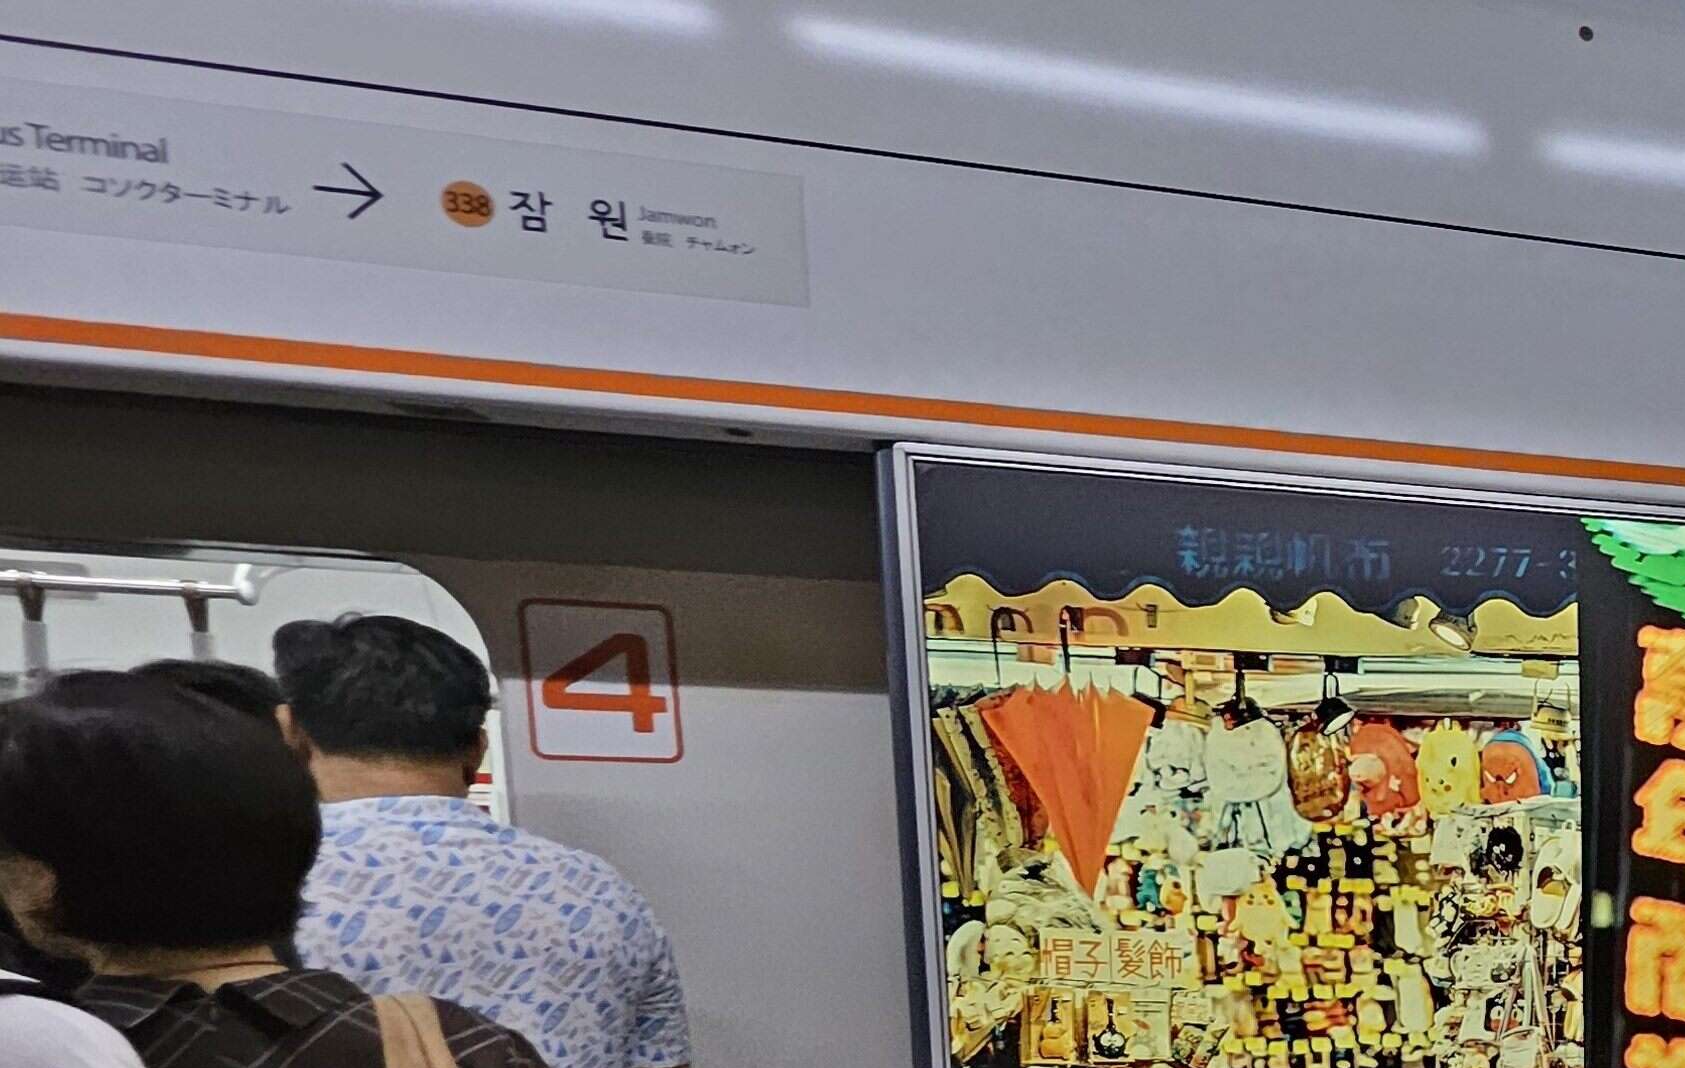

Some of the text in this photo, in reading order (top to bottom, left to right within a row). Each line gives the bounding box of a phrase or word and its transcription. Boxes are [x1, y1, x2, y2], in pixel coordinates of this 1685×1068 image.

[24, 121, 169, 164] Terminal
[445, 190, 492, 217] 338
[638, 205, 718, 229] Jamwon
[542, 633, 668, 733] 4
